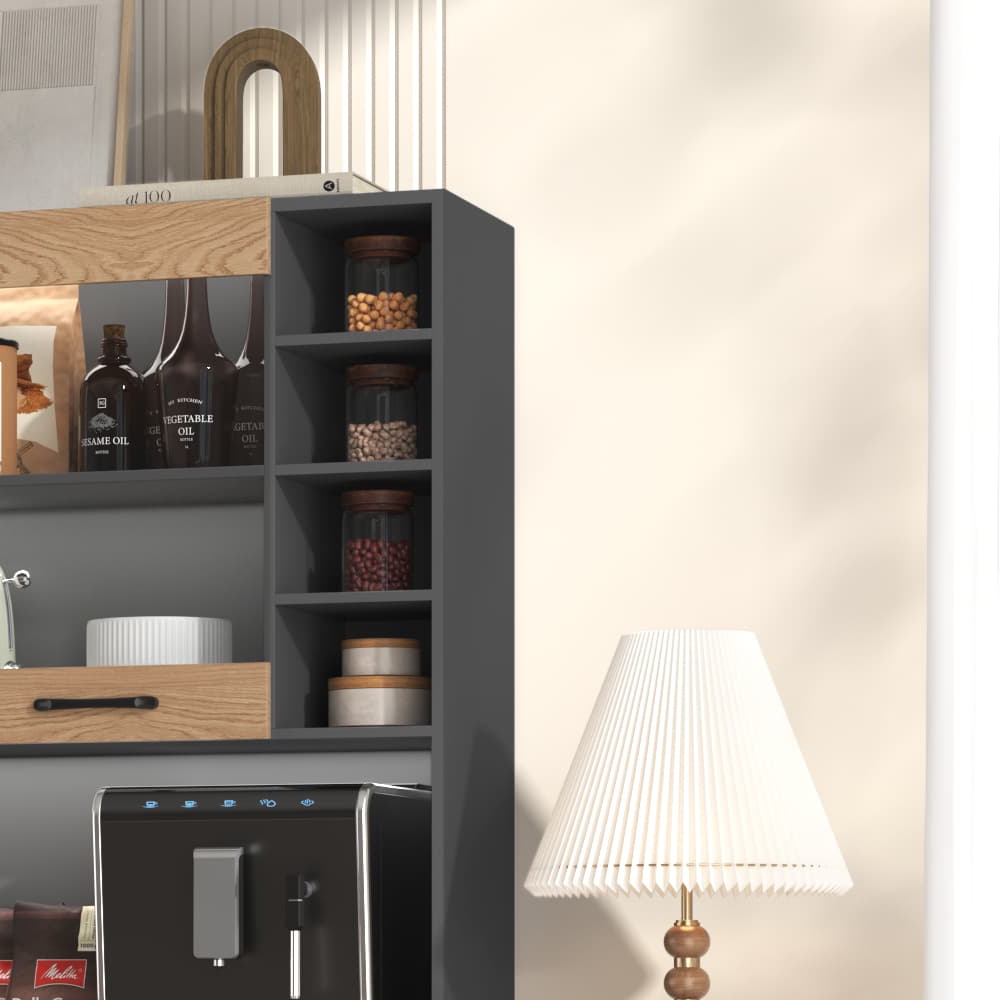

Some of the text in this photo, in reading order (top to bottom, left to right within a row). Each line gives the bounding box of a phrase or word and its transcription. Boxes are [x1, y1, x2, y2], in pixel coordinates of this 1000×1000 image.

[163, 414, 214, 424] VEGETABLE
[178, 427, 195, 436] OIL
[112, 436, 130, 445] OIL
[241, 434, 258, 443] OIL
